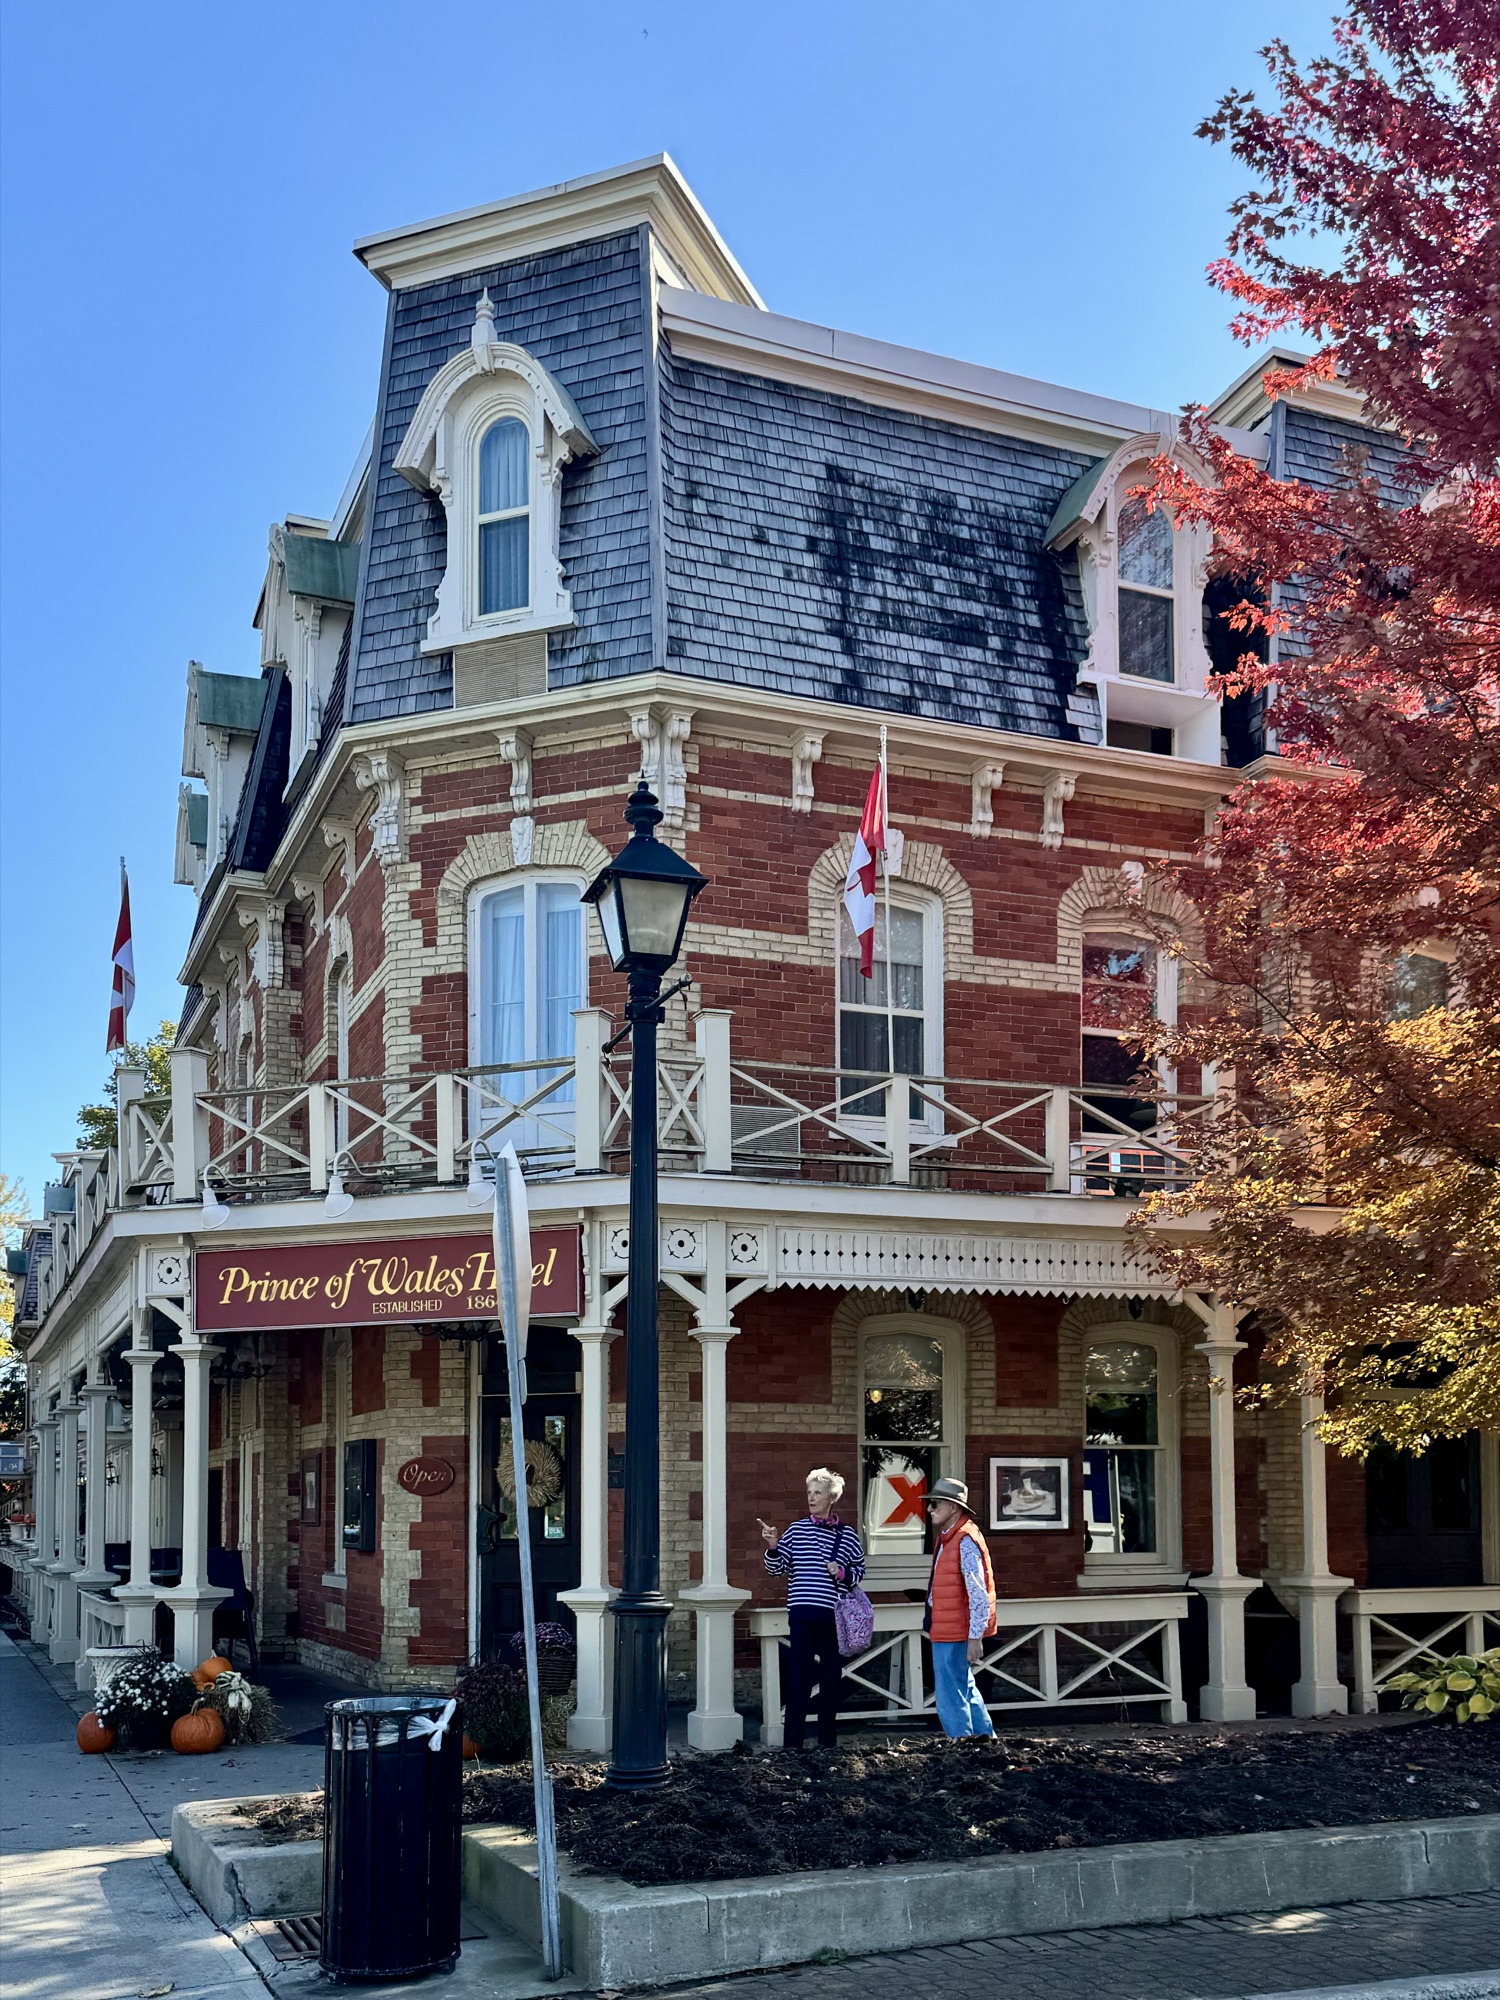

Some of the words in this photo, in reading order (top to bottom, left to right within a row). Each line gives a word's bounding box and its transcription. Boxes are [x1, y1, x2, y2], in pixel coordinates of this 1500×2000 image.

[218, 1266, 320, 1305] Prince
[324, 1257, 365, 1310] of
[361, 1254, 465, 1298] Wales
[465, 1247, 558, 1292] Hel
[372, 1299, 443, 1315] ESTABLISHED
[466, 1294, 498, 1310] 186
[403, 1463, 447, 1490] Open
